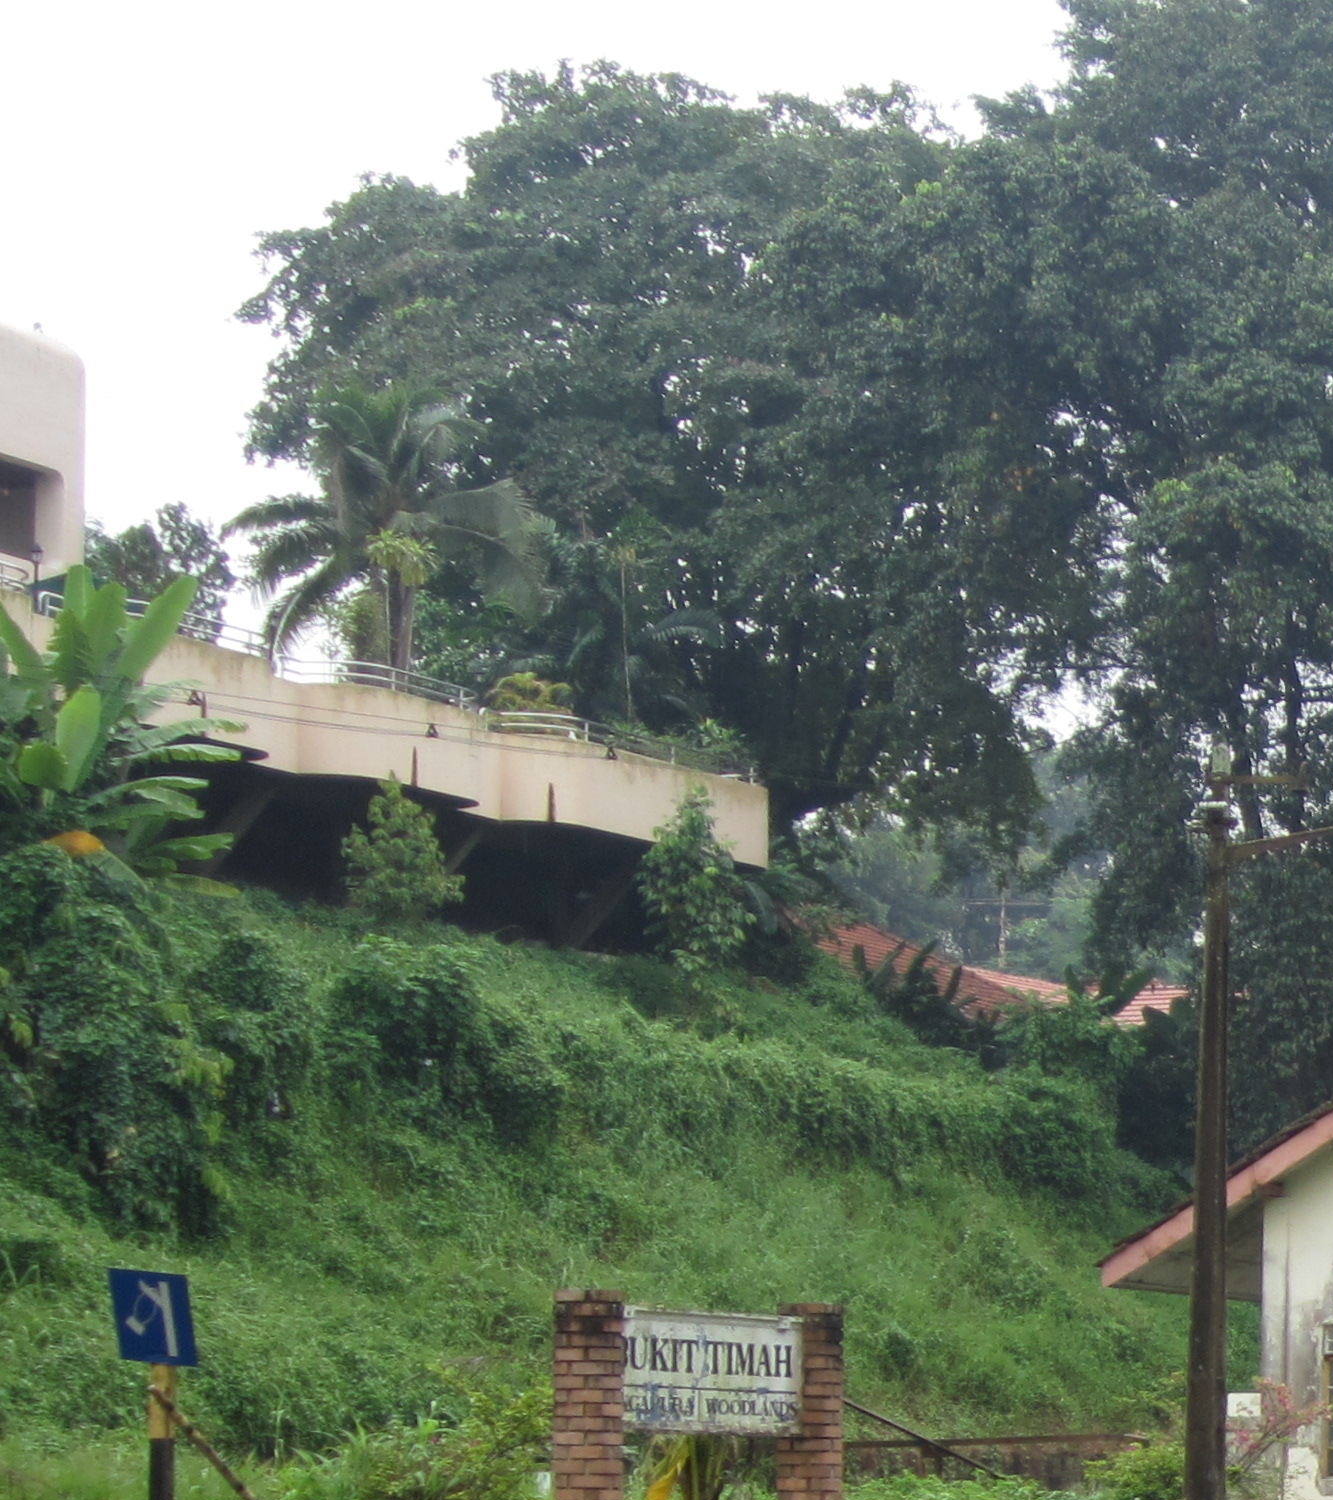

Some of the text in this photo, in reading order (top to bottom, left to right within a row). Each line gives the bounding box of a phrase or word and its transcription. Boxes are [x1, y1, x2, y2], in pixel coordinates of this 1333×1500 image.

[622, 1335, 793, 1378] UKIT TIMAH
[705, 1397, 799, 1418] WOODLANDS
